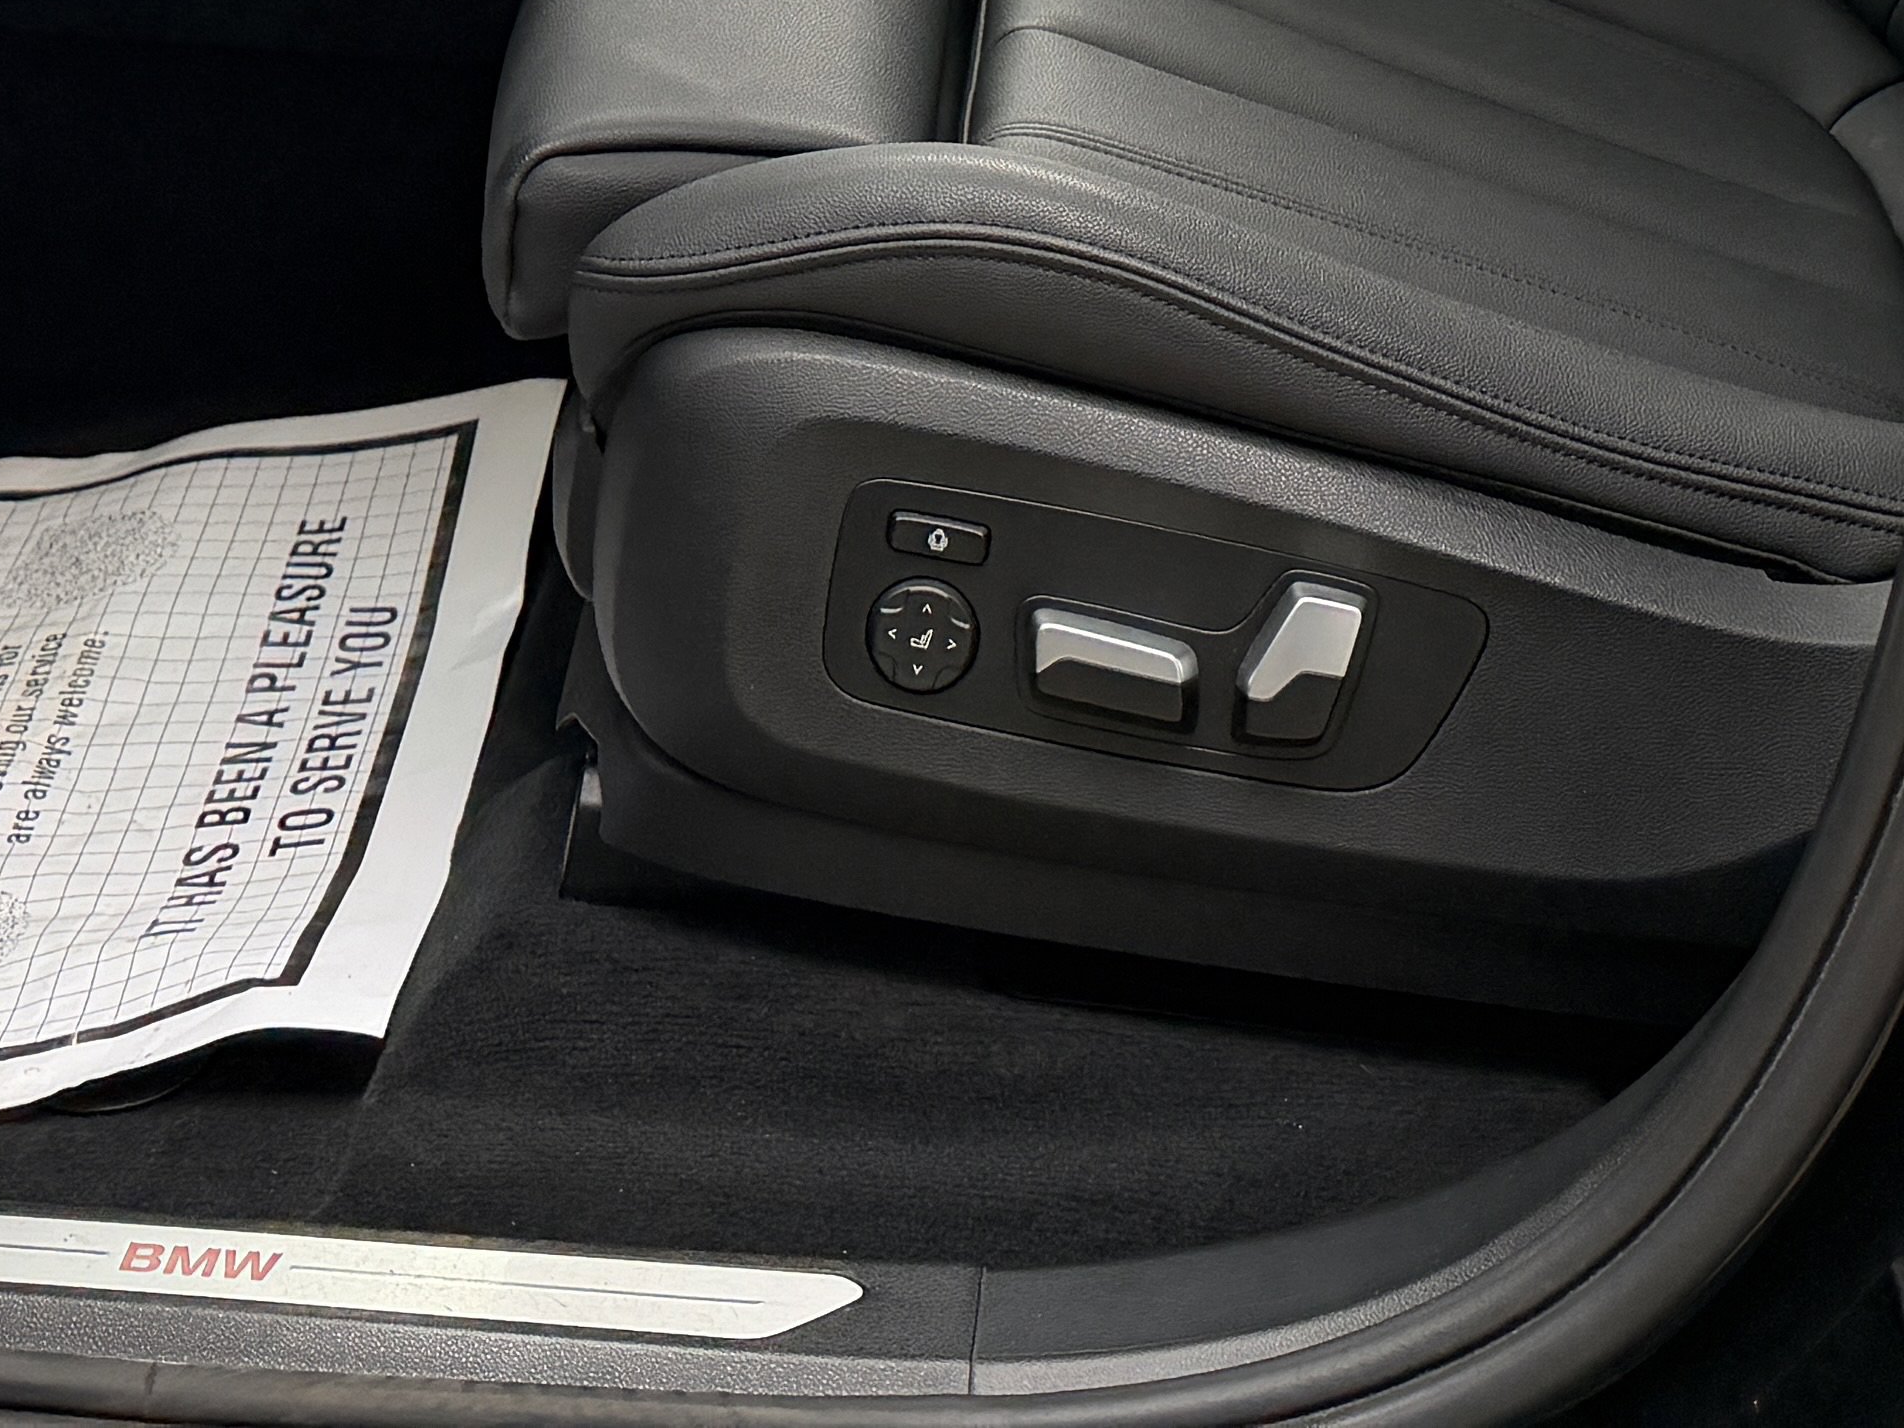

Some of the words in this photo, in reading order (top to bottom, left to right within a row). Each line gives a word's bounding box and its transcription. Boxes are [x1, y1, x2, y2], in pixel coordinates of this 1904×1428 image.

[245, 516, 347, 693] PLEASURE
[335, 606, 397, 677] YOU
[6, 705, 36, 734] our
[23, 632, 67, 697] service
[54, 631, 109, 727] welcome.
[235, 706, 289, 728] A
[290, 686, 376, 795] SERVE
[22, 734, 71, 800] always
[196, 741, 279, 828] BEEN
[7, 810, 40, 844] are
[268, 807, 335, 857] TO
[166, 844, 239, 907] HAS
[137, 917, 205, 941] IT
[119, 1241, 284, 1281] BMW
